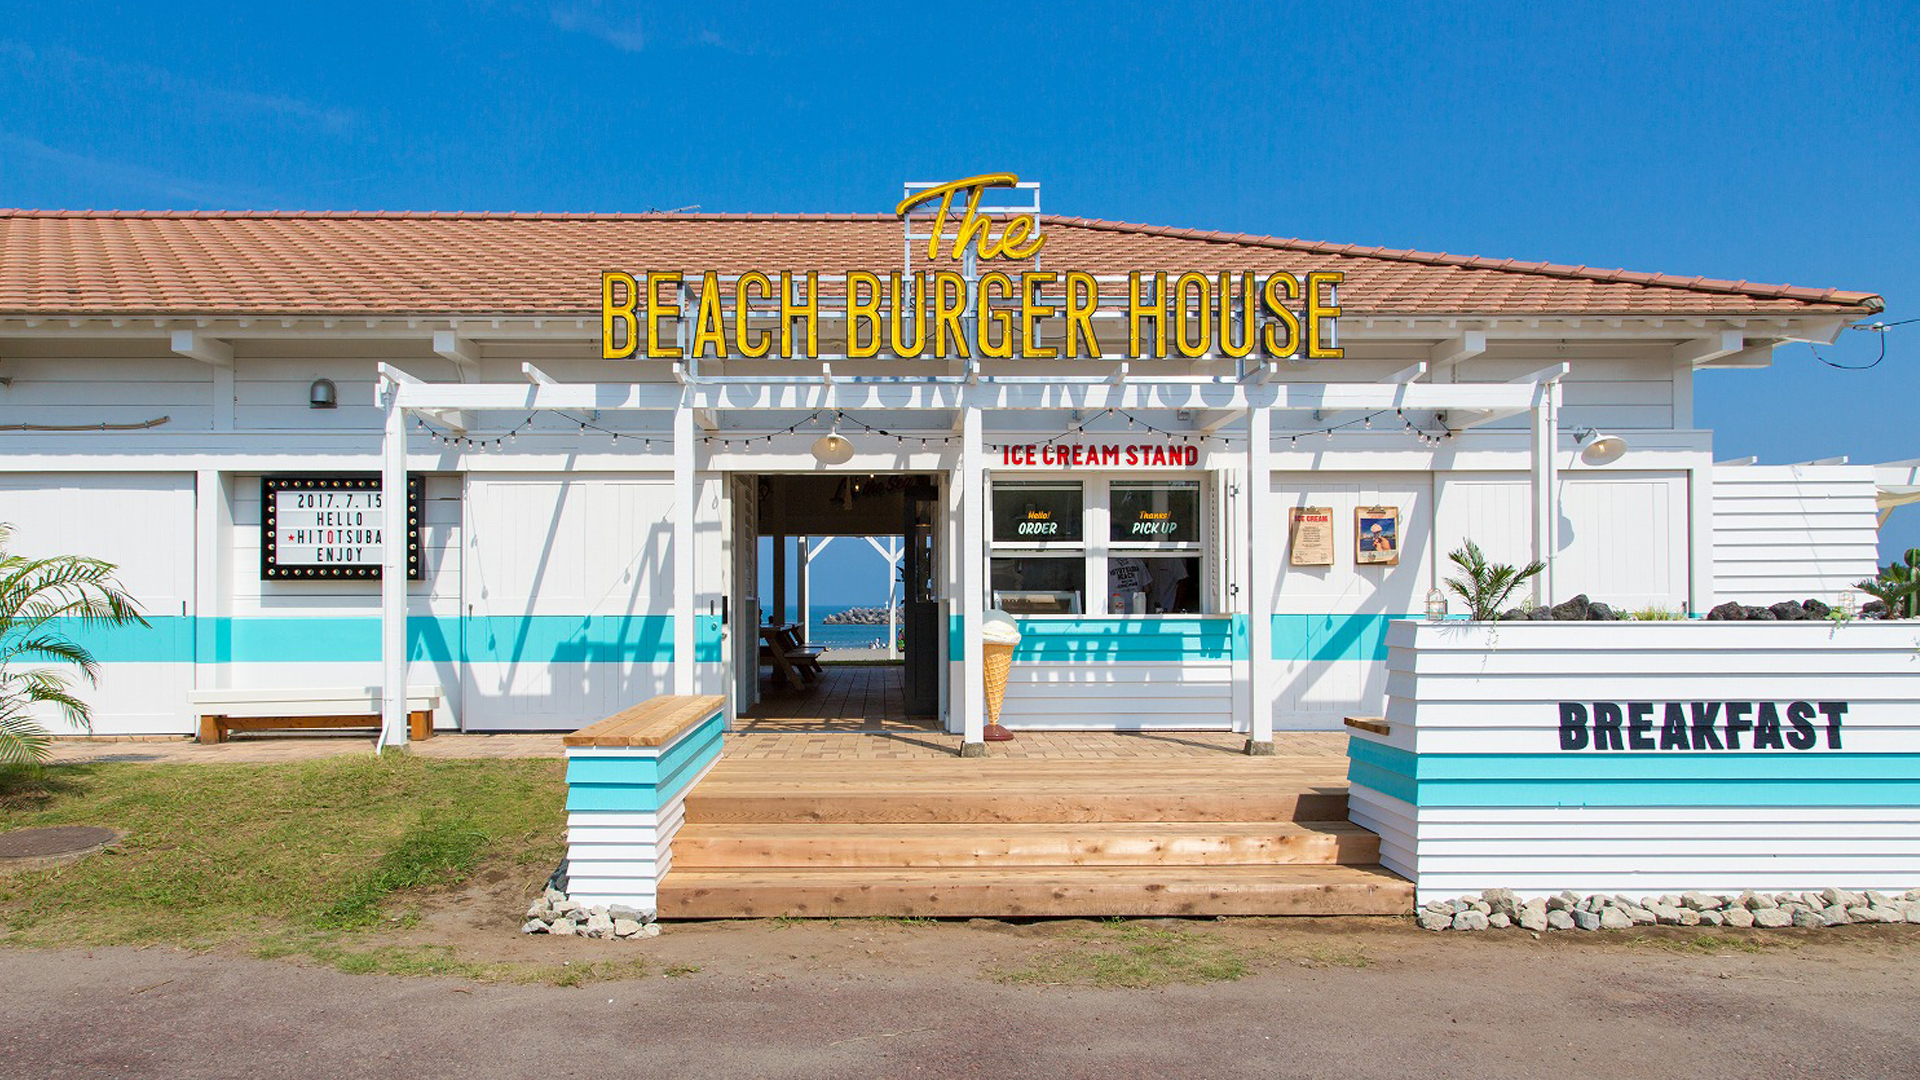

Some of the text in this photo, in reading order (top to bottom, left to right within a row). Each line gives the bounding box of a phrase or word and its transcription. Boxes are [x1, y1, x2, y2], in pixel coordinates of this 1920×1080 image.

[895, 171, 1048, 261] The
[601, 270, 1346, 360] BEACH BURGER HOUSE
[1003, 444, 1199, 466] ICE CREAM STAND
[317, 512, 363, 526] HELLO
[1028, 510, 1051, 519] Hello!
[1139, 510, 1172, 519] Thanks!
[1018, 522, 1058, 535] ORDER
[1131, 522, 1178, 535] PICK UP
[297, 529, 382, 544] HITOTSUBA
[317, 547, 363, 562] ENJOY
[1558, 701, 1849, 751] BREAKFAST
